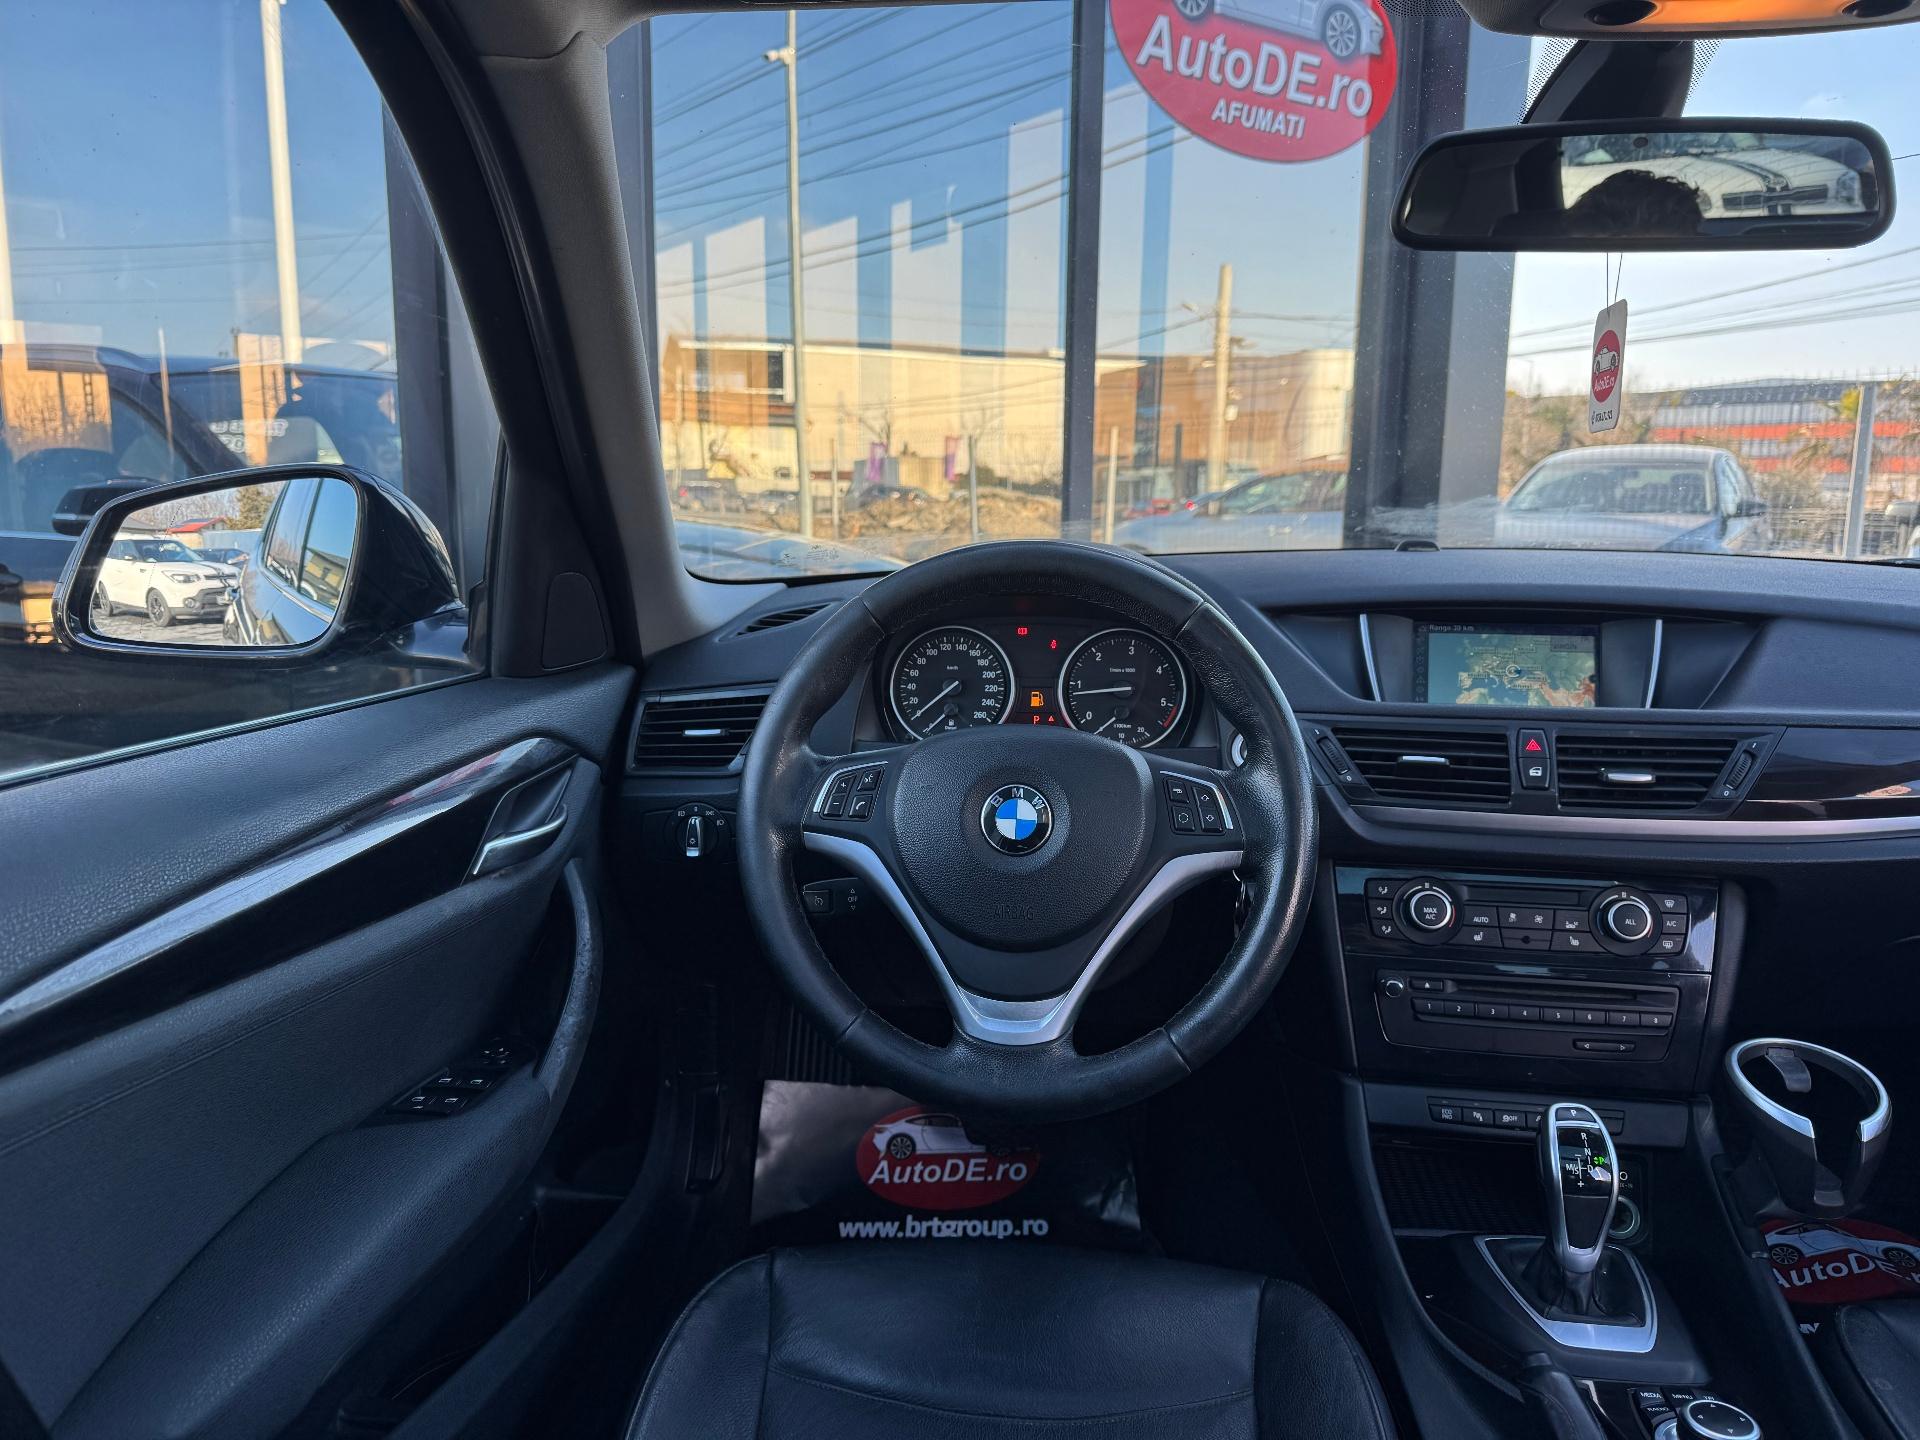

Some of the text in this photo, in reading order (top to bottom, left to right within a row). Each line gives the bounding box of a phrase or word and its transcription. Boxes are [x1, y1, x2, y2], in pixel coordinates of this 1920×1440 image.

[1135, 15, 1373, 117] AutoDE.ro
[1211, 98, 1306, 139] AFUMATI
[1129, 647, 1134, 655] 3
[1096, 653, 1101, 661] 2
[1156, 666, 1162, 674] 4
[1077, 681, 1081, 689] 1
[1160, 698, 1166, 706] 5
[973, 711, 987, 719] 260
[1086, 711, 1092, 720] 0
[991, 787, 1045, 810] BMW
[1625, 918, 1637, 926] ALL
[1570, 1109, 1577, 1117] P
[1581, 1132, 1588, 1140] R
[1584, 1147, 1591, 1156] N
[868, 1157, 1028, 1185] AutoDE.ro
[1587, 1165, 1594, 1173] D
